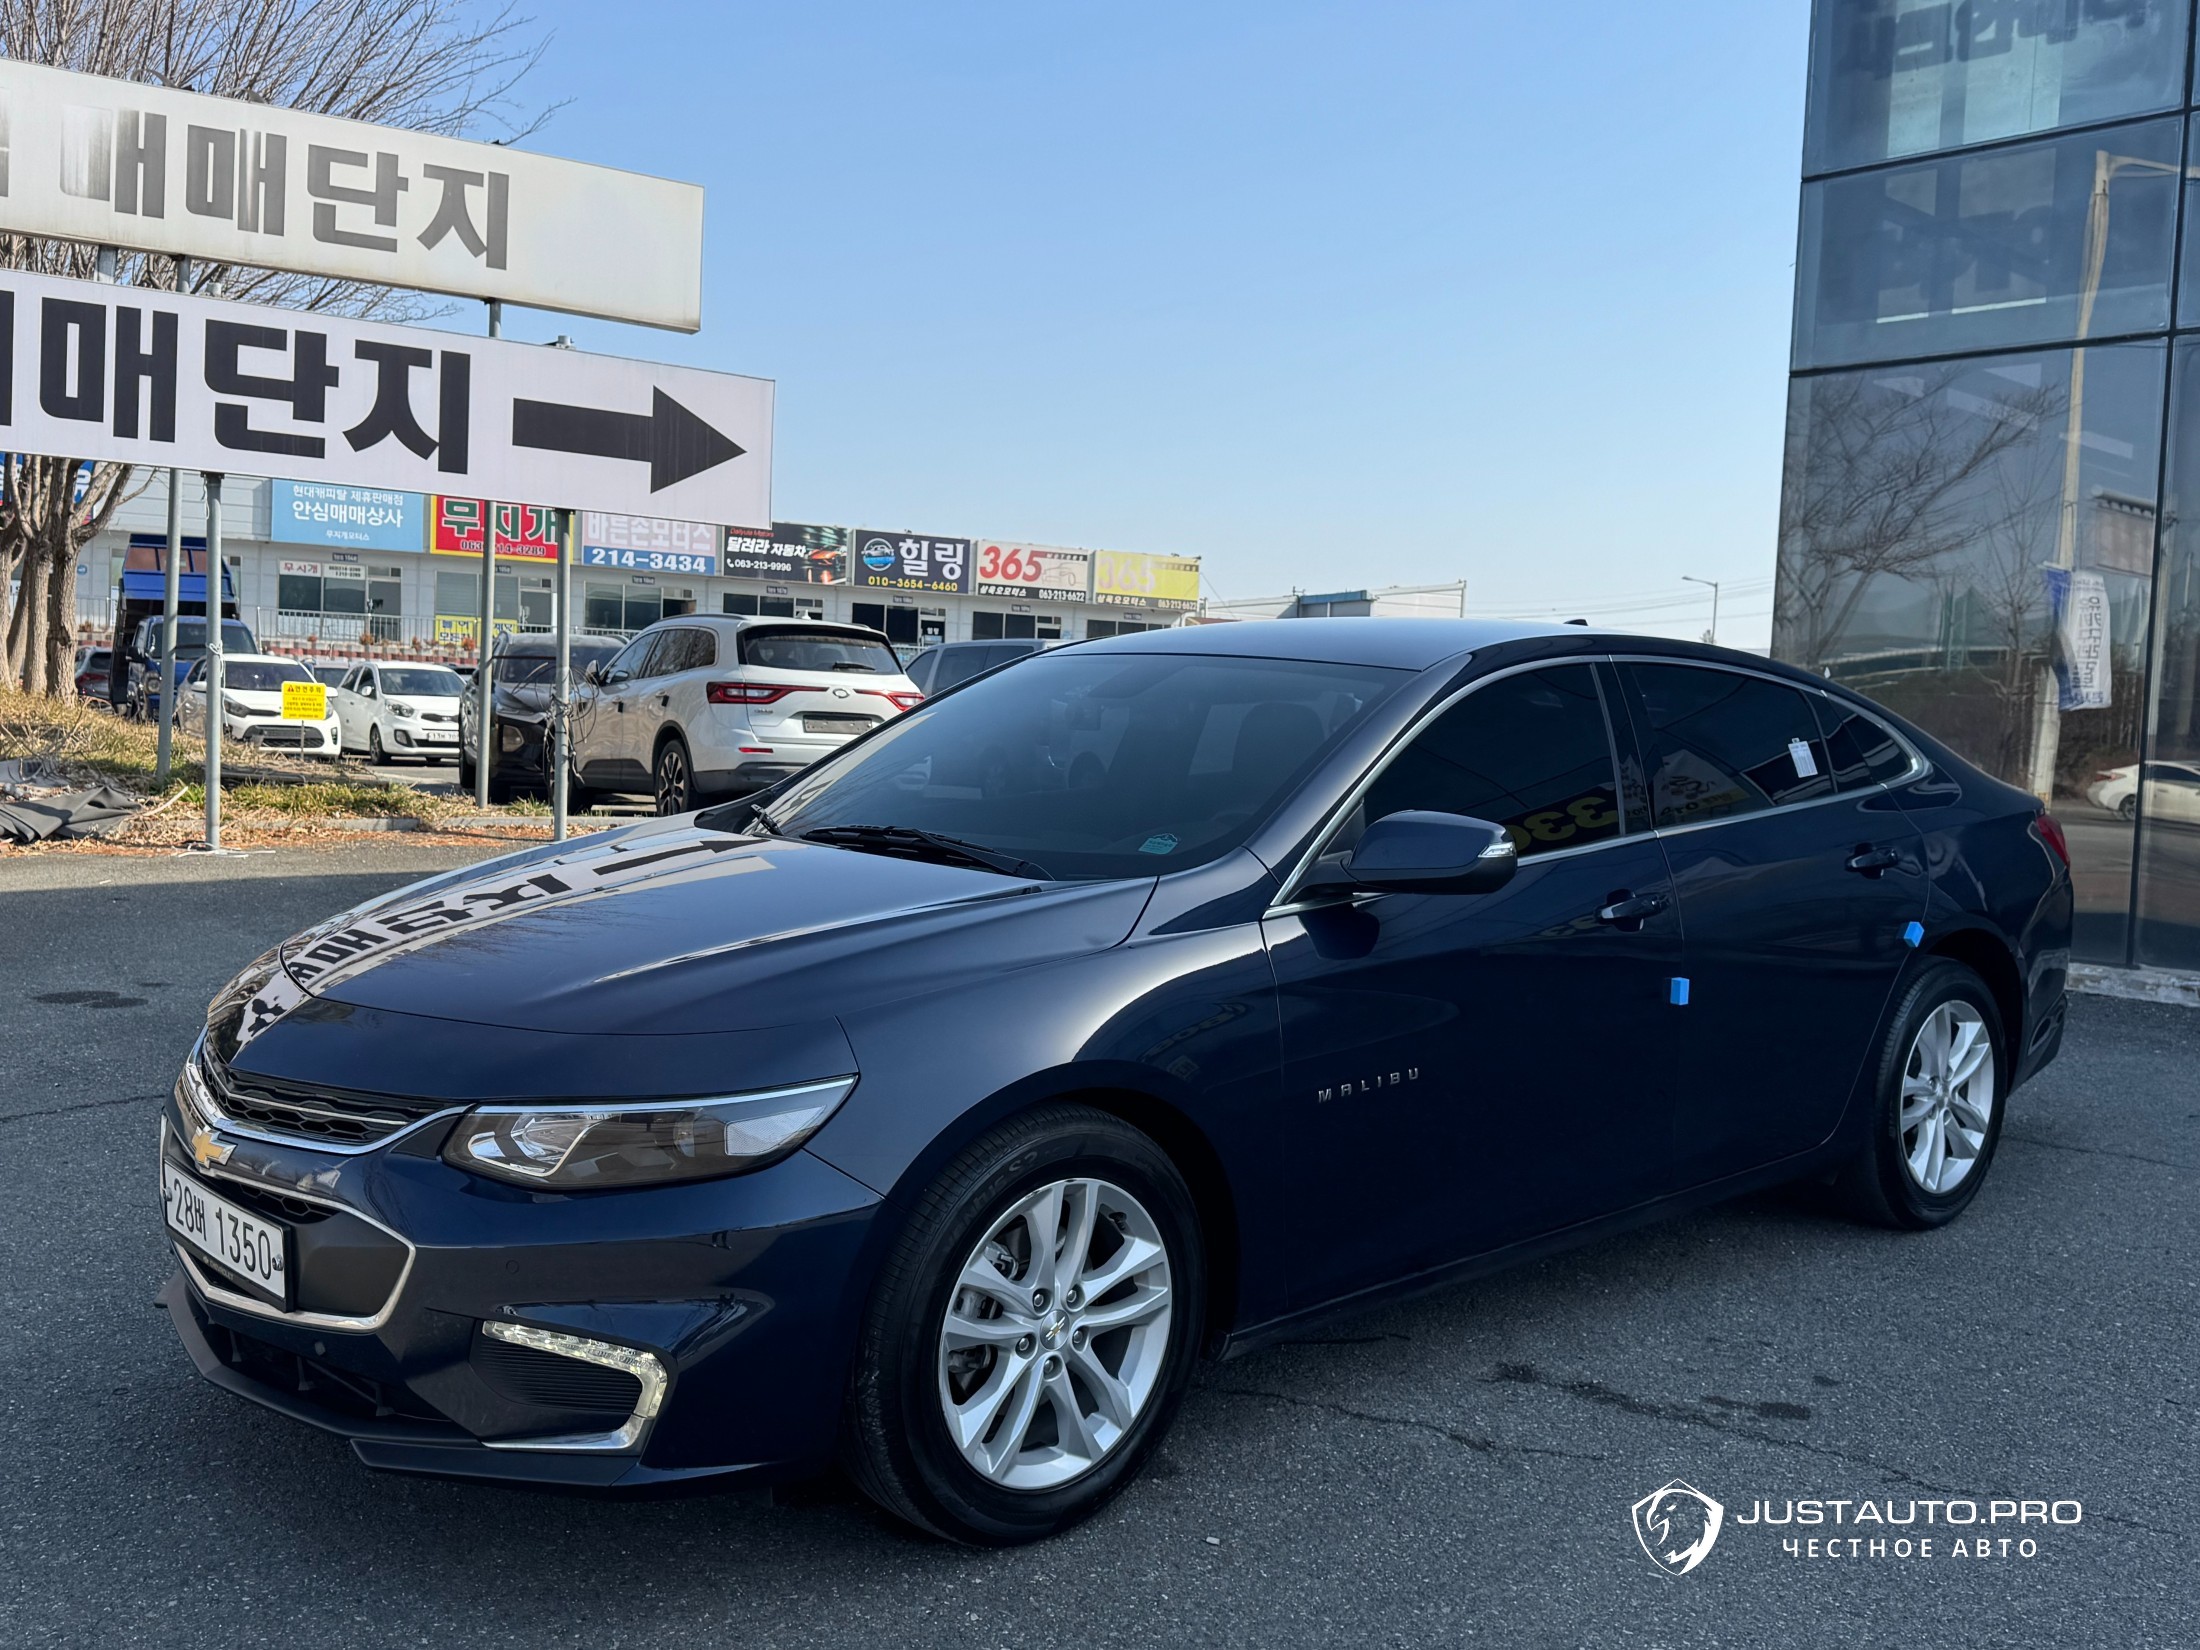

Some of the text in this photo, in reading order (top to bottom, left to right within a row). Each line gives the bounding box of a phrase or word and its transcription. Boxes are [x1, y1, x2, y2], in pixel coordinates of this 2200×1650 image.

[59, 105, 510, 271] 매매단지
[0, 289, 471, 475] 매단지
[293, 485, 347, 502] 현대캐피탈
[292, 500, 404, 528] 안심매매상사
[591, 547, 706, 573] 214-3434
[727, 536, 807, 558] 달려라 자동차
[898, 538, 965, 580] 힐링
[735, 559, 792, 572] 063-213-9996
[979, 545, 1044, 582] 365
[868, 575, 958, 592] 010-3654-6460
[1038, 589, 1085, 602] 063-213-6622
[1318, 1067, 1419, 1104] MALIBU
[215, 1206, 271, 1281] 1350
